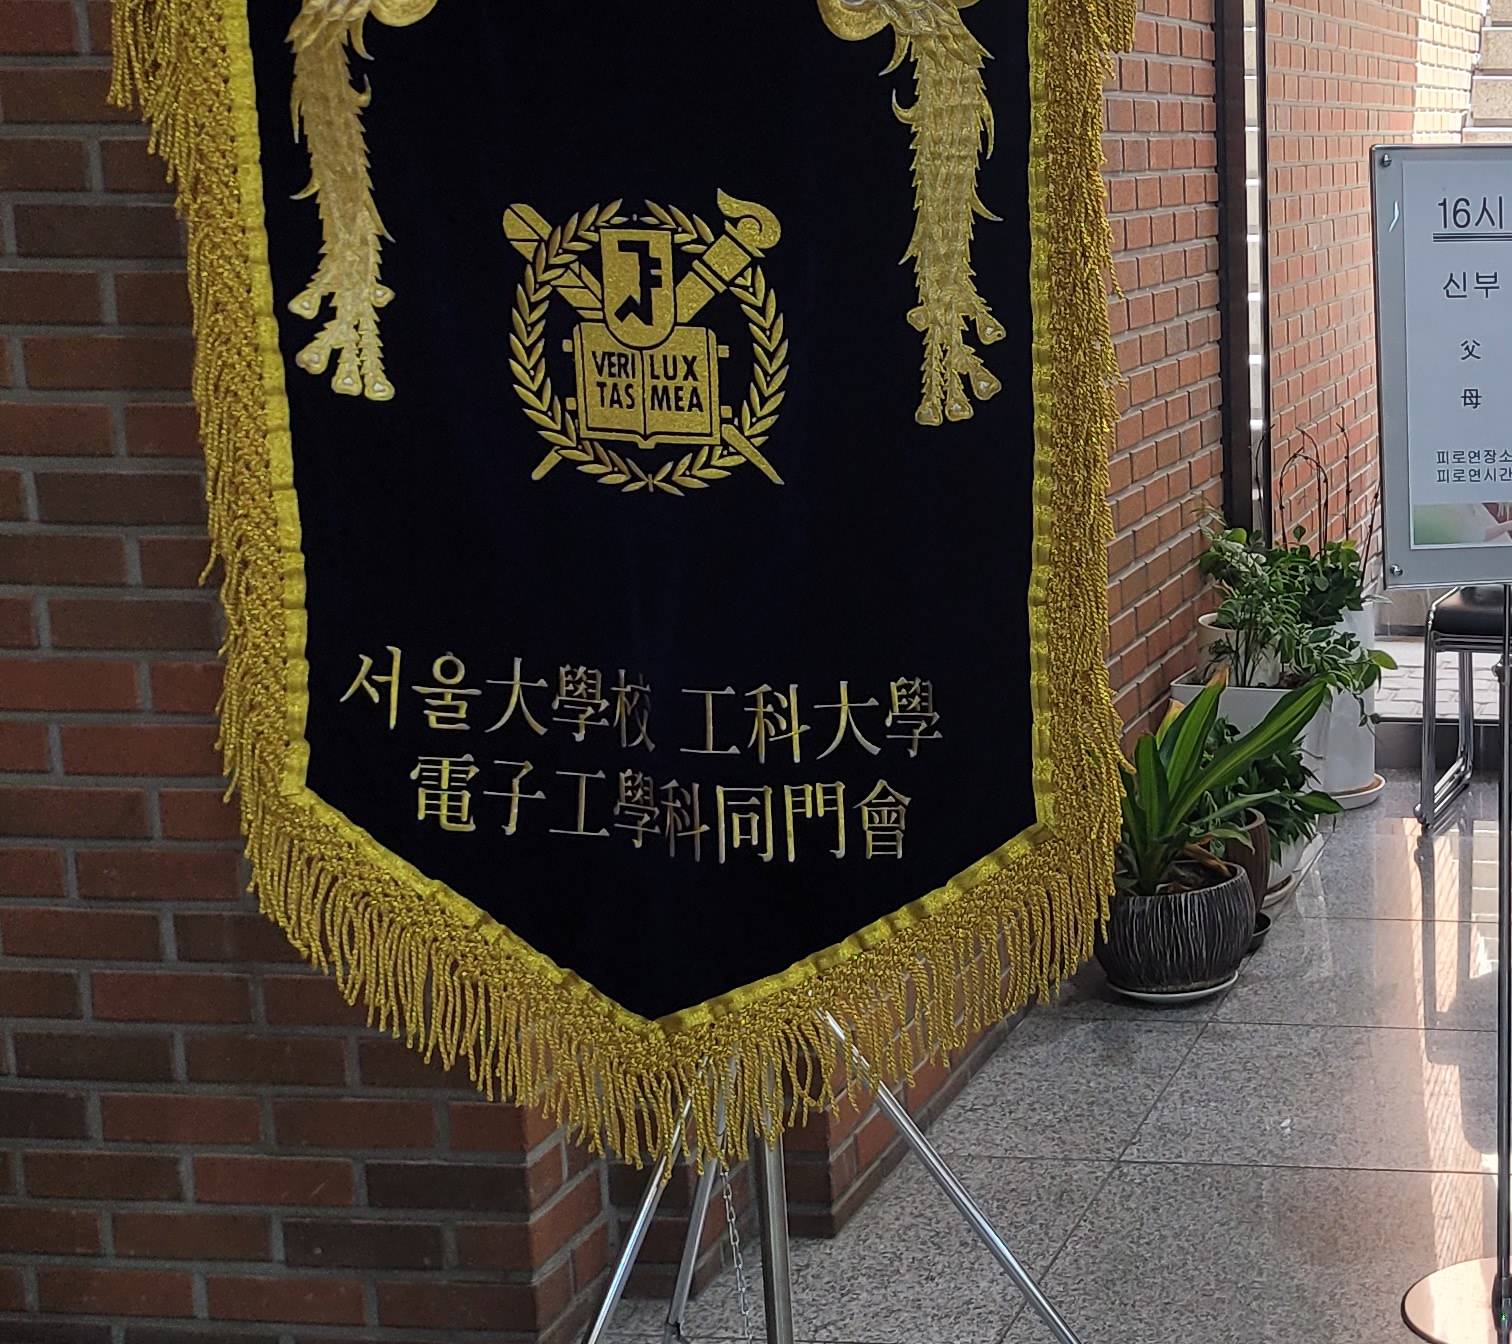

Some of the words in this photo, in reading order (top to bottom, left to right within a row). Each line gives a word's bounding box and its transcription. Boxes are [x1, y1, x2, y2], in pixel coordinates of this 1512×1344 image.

[1438, 196, 1502, 229] 16시
[1443, 272, 1499, 298] 신부
[1461, 340, 1480, 360] 父
[592, 351, 636, 379] VERI
[649, 354, 699, 381] LUX
[596, 381, 635, 409] TAS
[651, 385, 704, 412] MEA
[1461, 389, 1482, 409] 母
[1437, 450, 1512, 464] 피로연장소
[1437, 467, 1512, 483] 피로연시간
[339, 645, 656, 753] 서울大學校
[680, 677, 942, 763] 工科大學
[410, 752, 912, 864] 電子工學科同門會
